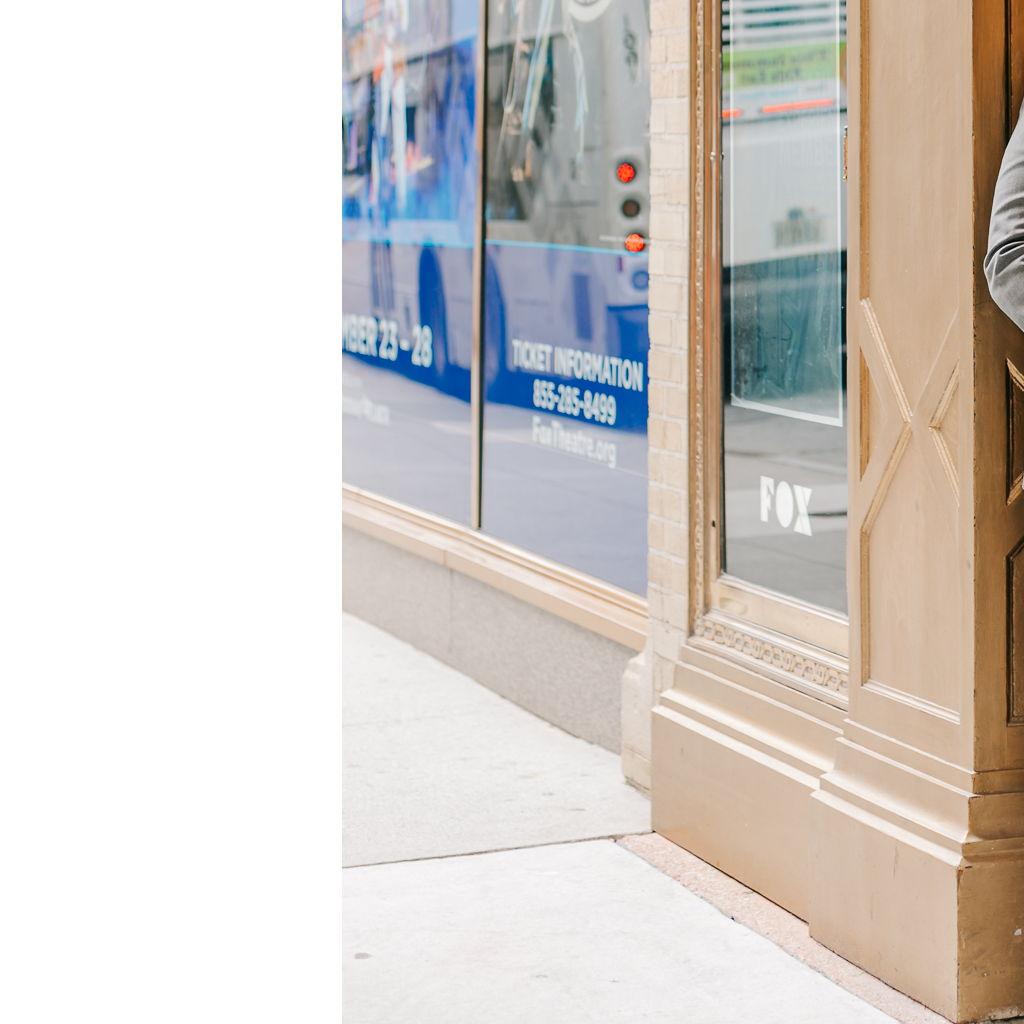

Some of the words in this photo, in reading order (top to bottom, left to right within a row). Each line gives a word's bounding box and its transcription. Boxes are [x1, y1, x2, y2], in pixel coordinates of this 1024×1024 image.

[379, 318, 398, 362] 23
[411, 323, 433, 368] 28
[511, 339, 553, 373] TICKET
[555, 343, 644, 392] INFORMATION
[532, 379, 616, 425] 855-285-8499
[532, 415, 616, 469] FoxTheatre.org
[760, 475, 812, 536] FOX
